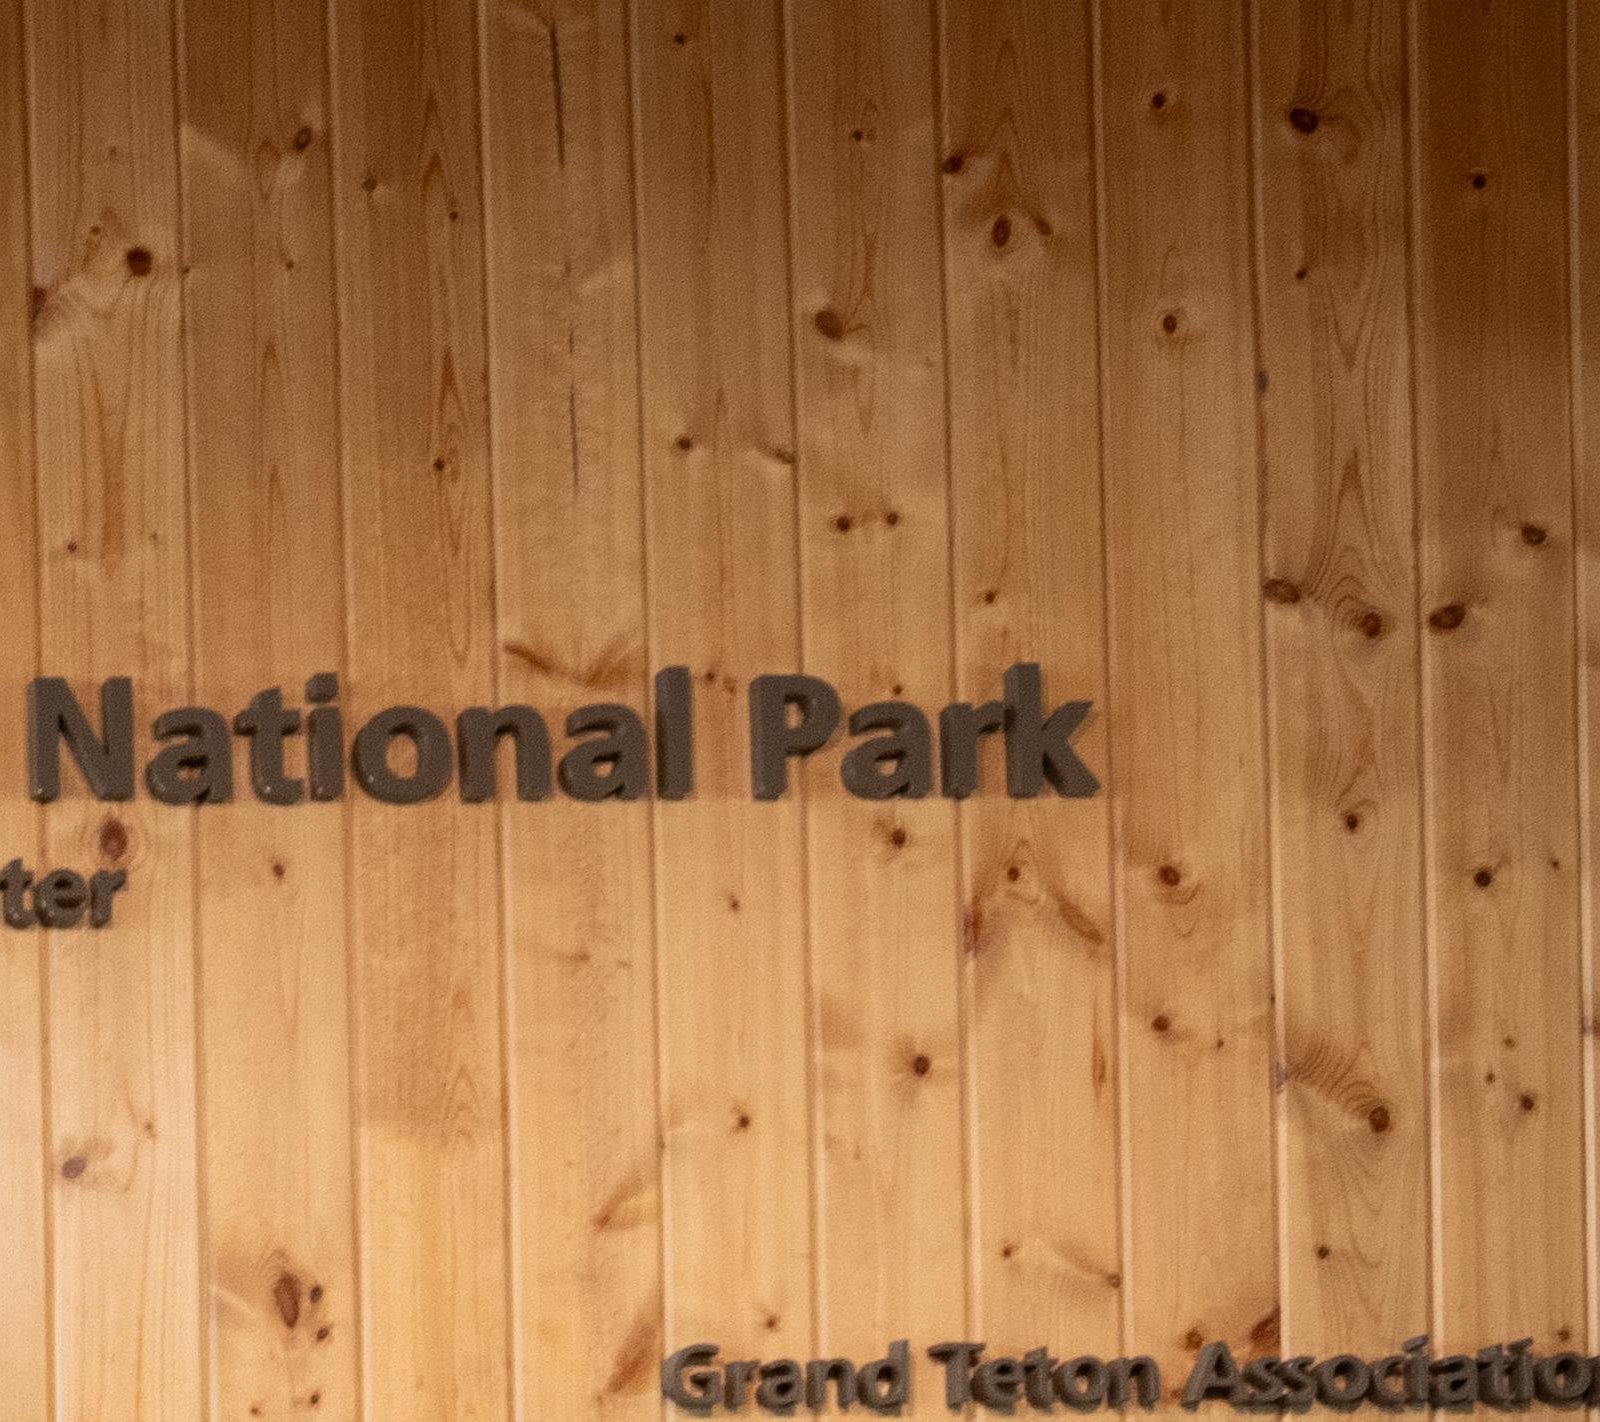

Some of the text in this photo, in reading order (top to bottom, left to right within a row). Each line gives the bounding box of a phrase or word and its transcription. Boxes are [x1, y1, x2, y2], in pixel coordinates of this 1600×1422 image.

[26, 665, 695, 807] National
[747, 662, 1100, 803] Park
[660, 1335, 1600, 1417] Grand Teton Associatio
